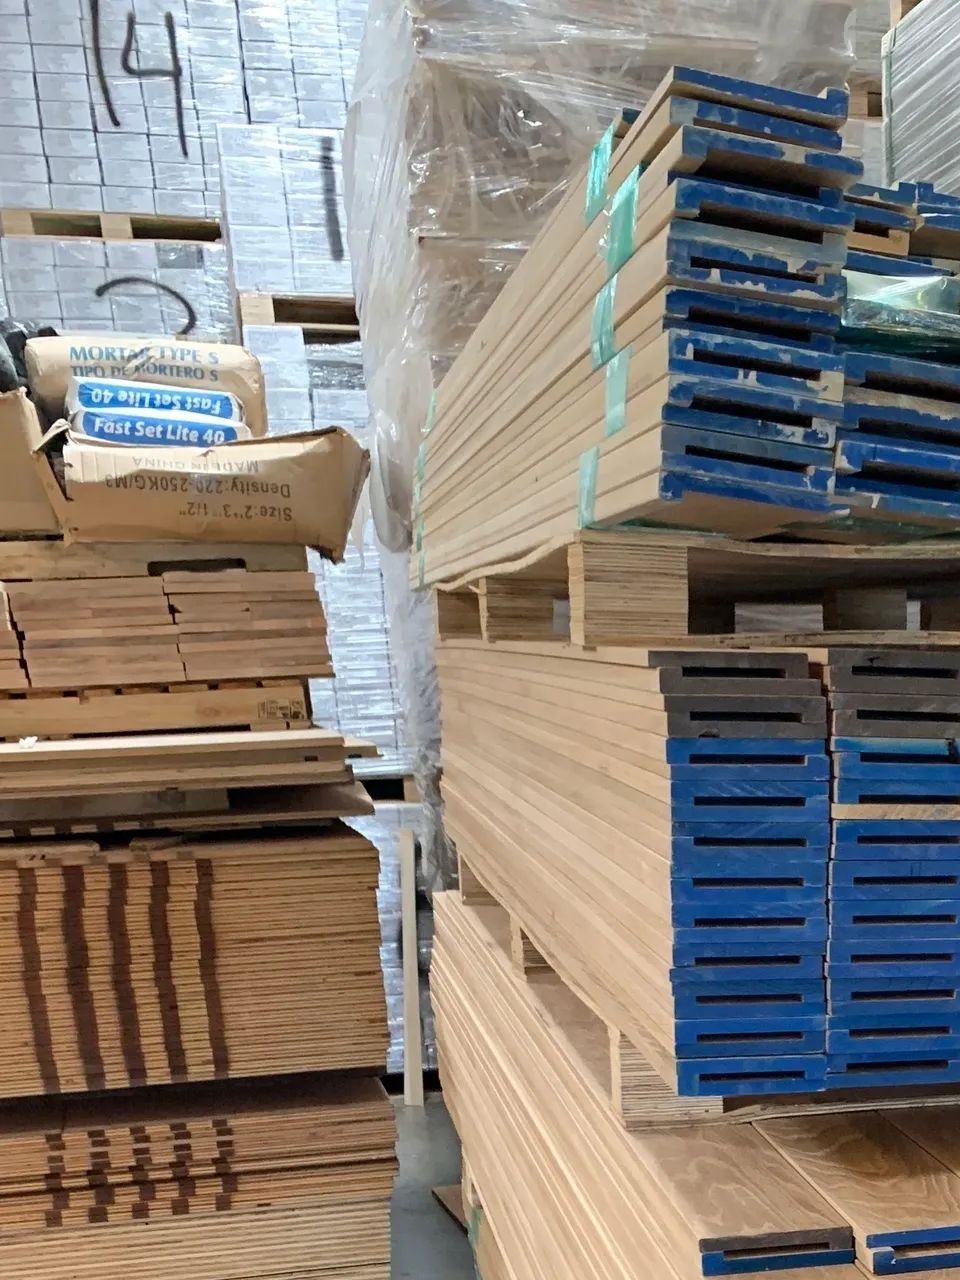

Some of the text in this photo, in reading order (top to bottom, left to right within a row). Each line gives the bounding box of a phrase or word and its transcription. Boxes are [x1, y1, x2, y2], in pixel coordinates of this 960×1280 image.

[158, 346, 201, 363] TYPE
[208, 351, 219, 365] S
[209, 369, 219, 382] S
[90, 387, 222, 416] Fast Set Lite 40
[93, 418, 225, 445] Fast Set Lite 40
